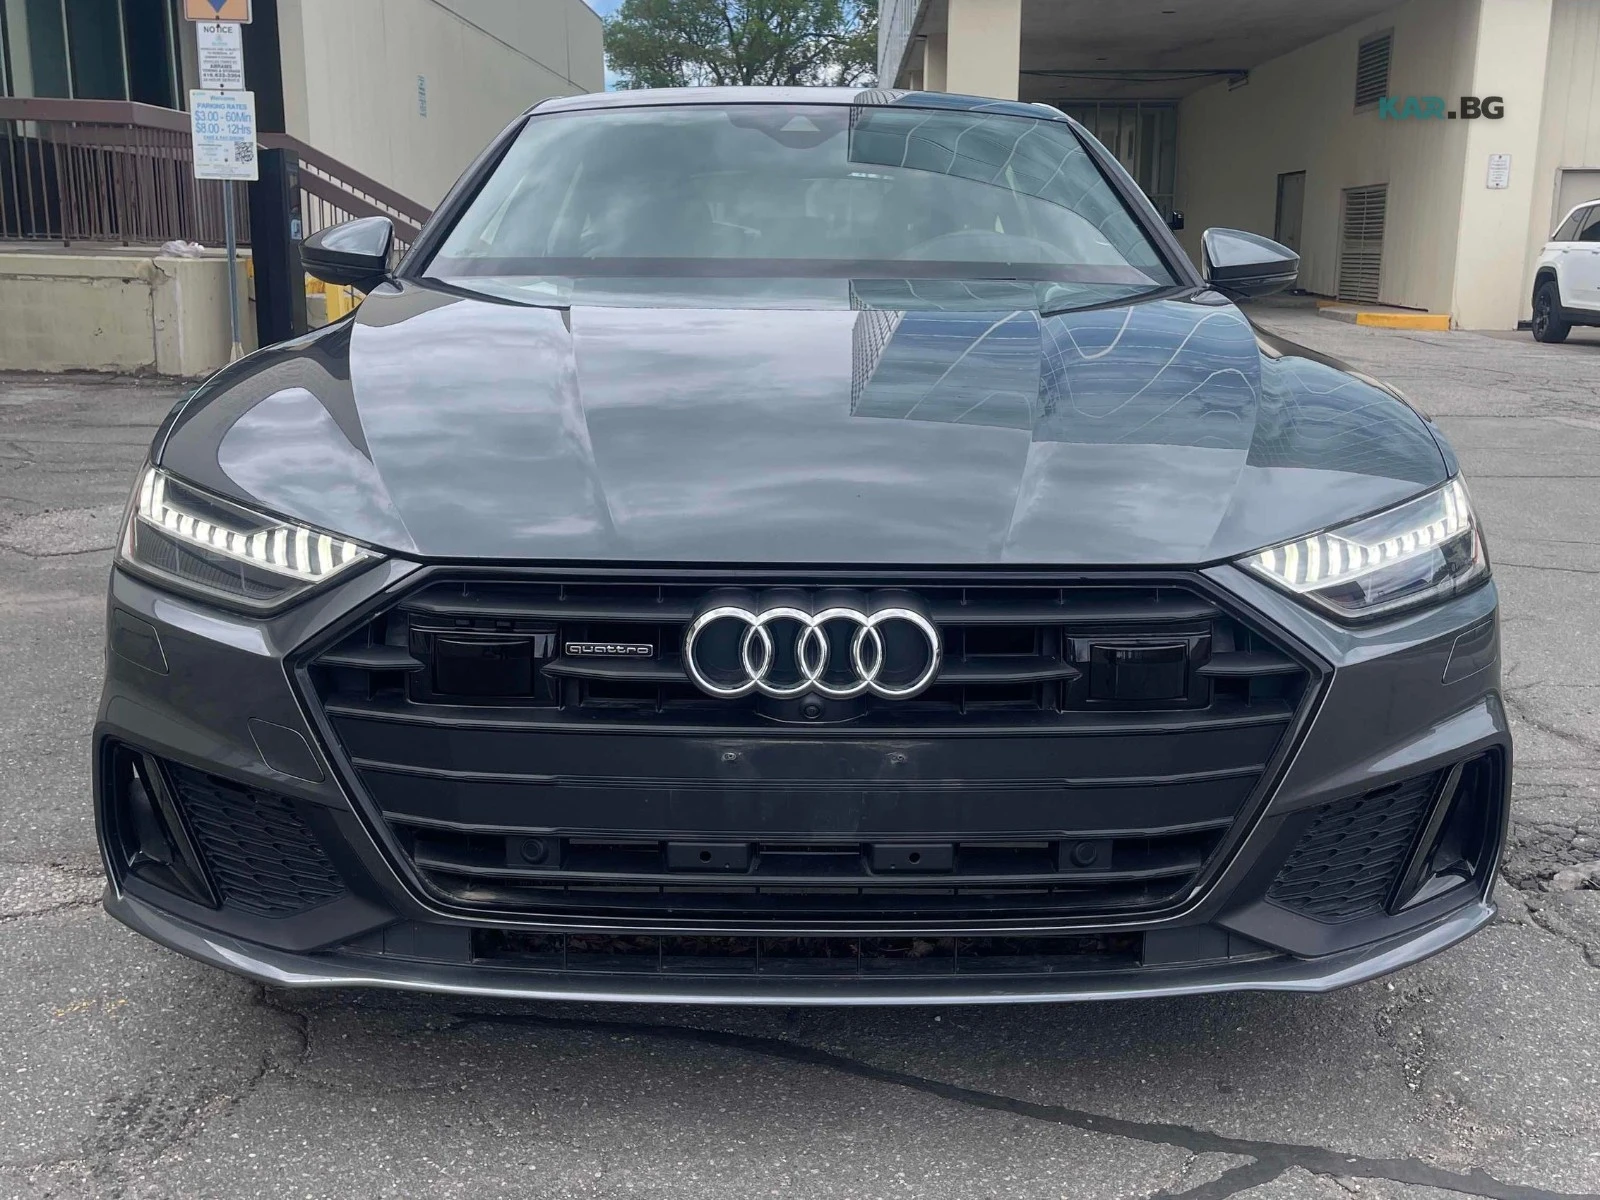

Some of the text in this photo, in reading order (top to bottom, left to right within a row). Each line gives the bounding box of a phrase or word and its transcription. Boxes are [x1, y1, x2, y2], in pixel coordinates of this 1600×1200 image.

[195, 110, 219, 121] $3.00
[225, 111, 251, 122] 60Min
[195, 122, 219, 133] $8.00
[228, 123, 252, 134] 12Hrs
[569, 645, 649, 654] quattro
